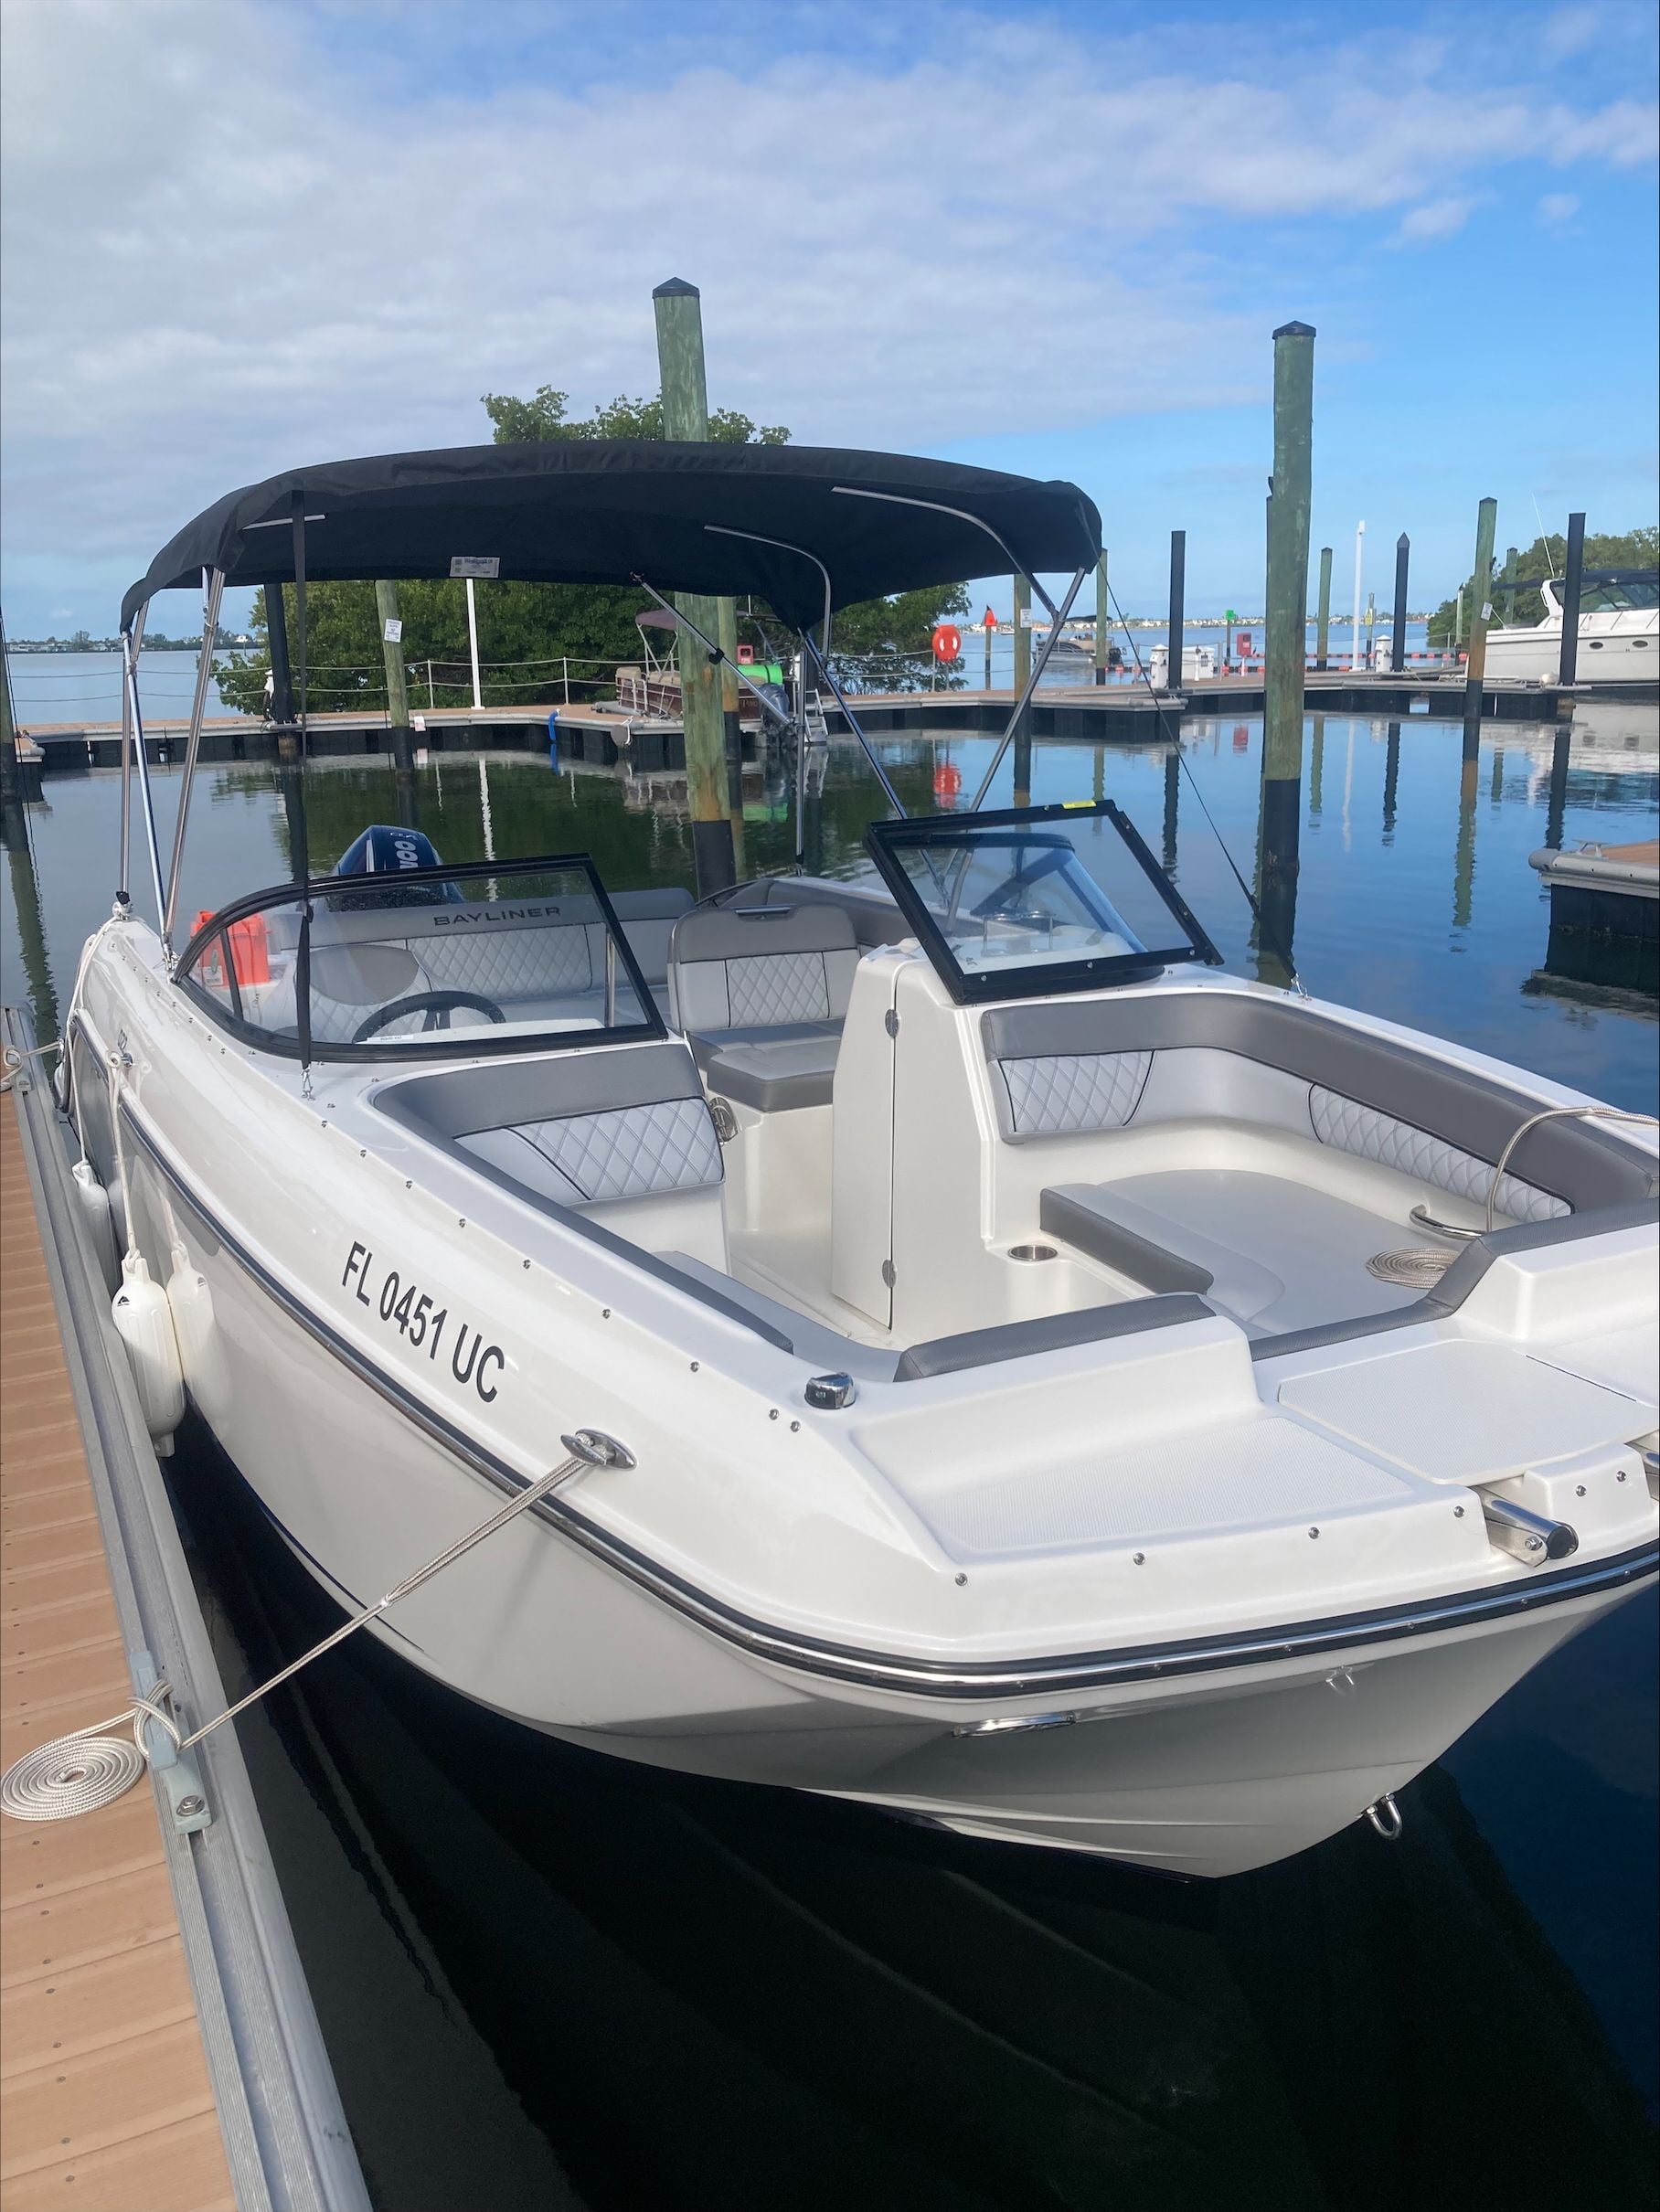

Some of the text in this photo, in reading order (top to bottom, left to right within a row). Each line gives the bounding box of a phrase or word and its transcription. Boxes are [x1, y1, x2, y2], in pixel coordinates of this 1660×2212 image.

[433, 907, 561, 926] BAYLINER
[342, 1240, 505, 1403] FL 0451 UC
